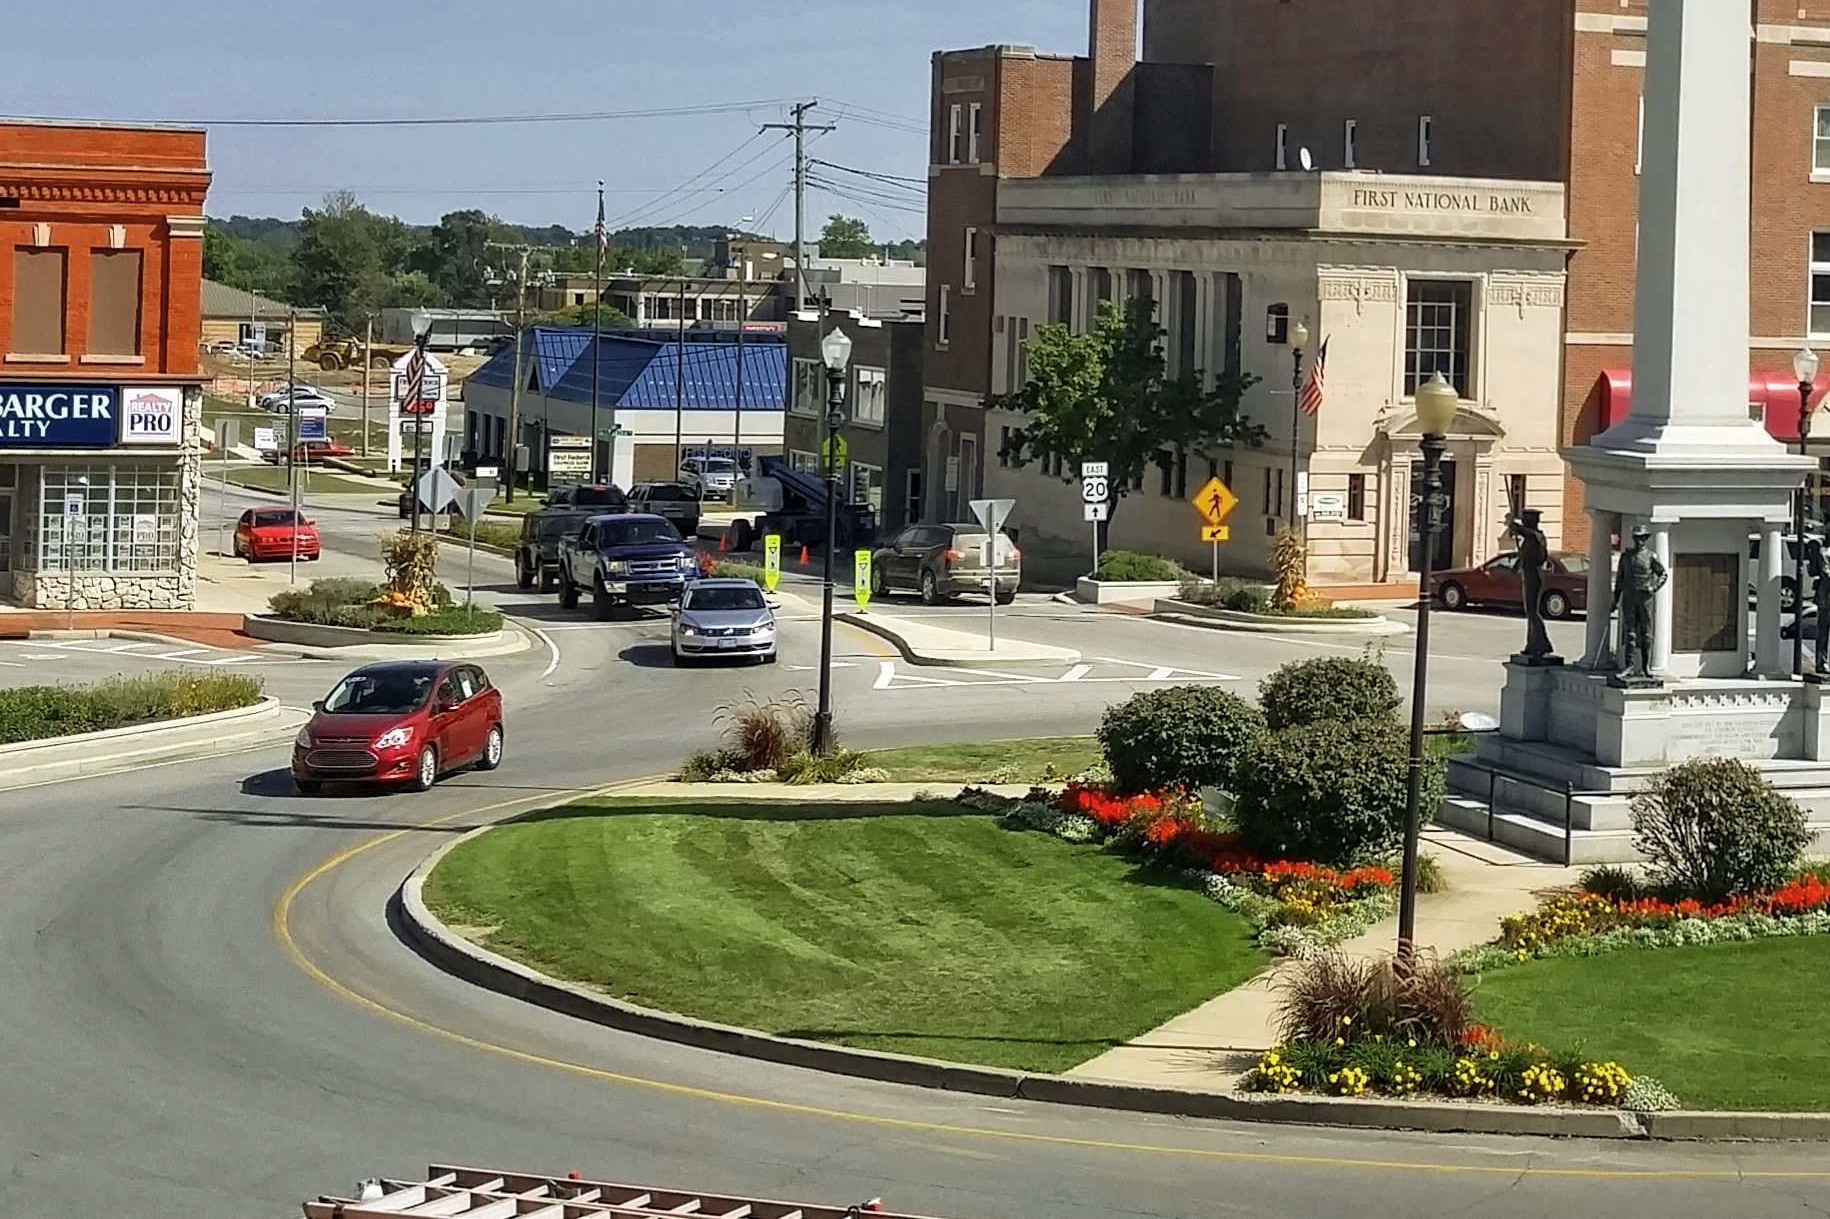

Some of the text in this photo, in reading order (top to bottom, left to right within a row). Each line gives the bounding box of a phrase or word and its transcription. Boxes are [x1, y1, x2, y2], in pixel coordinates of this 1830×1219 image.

[1353, 189, 1532, 213] FIRST NATIONAL BANK
[131, 401, 172, 413] REALTY
[130, 413, 171, 432] PRO
[1086, 465, 1104, 473] EAST
[1086, 483, 1105, 496] 20
